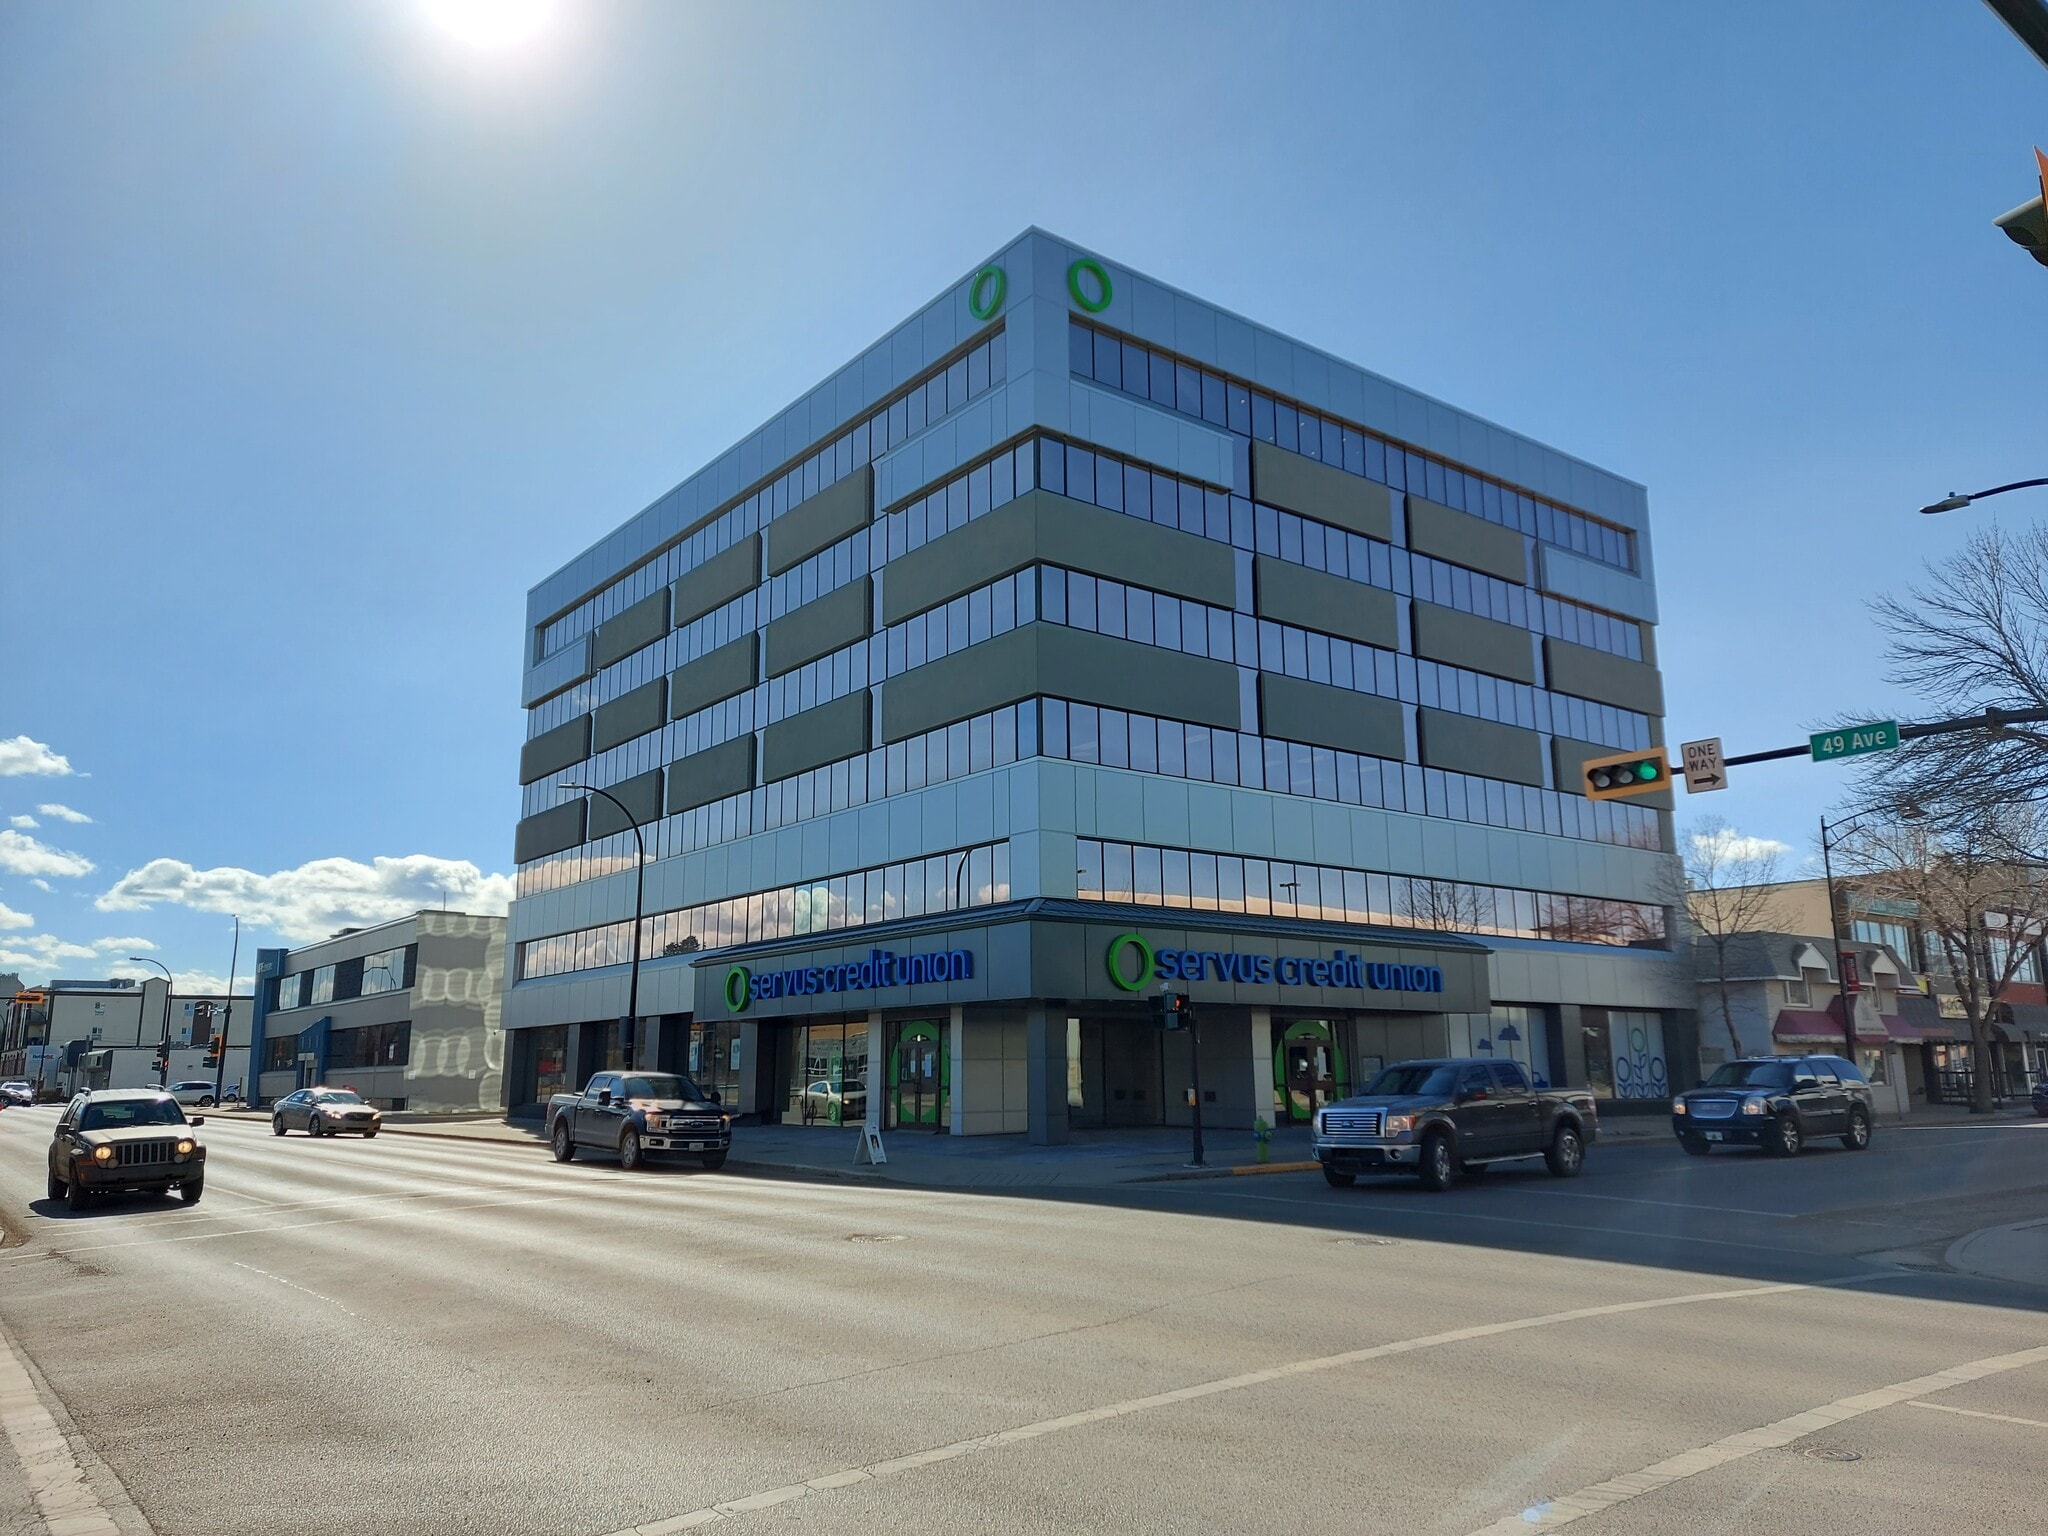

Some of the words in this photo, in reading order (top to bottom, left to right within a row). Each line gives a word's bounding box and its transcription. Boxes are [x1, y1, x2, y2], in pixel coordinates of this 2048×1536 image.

[1688, 743, 1715, 758] ONE
[1823, 735, 1844, 753] 49
[1852, 730, 1886, 749] Ave
[1689, 757, 1717, 771] WAY
[750, 967, 820, 999] servus
[823, 949, 891, 992] credit
[1156, 949, 1274, 984] servus
[1277, 950, 1366, 988] credit
[1367, 962, 1444, 993] union
